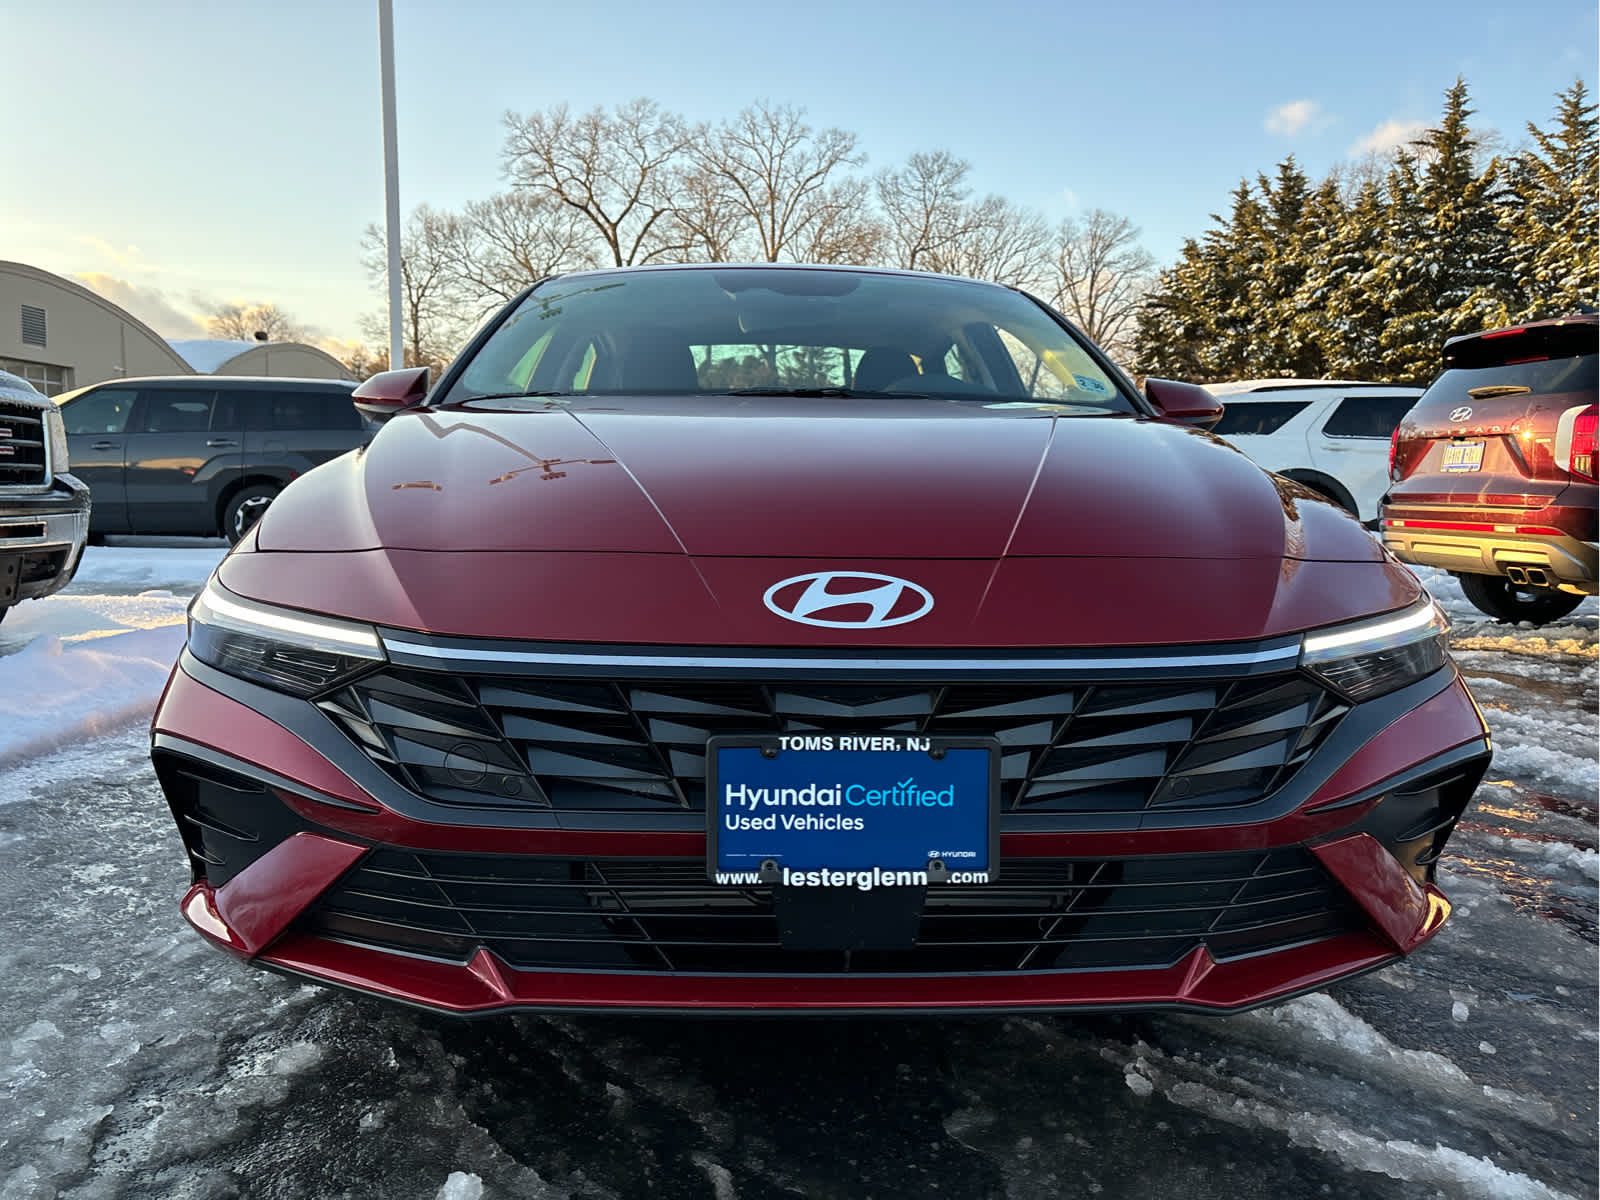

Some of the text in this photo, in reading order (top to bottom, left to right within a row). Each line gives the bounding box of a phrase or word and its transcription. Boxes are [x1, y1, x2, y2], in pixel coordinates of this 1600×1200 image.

[779, 736, 931, 752] TOMS RIVER, NJ
[725, 777, 954, 811] Hyundai Certified
[725, 813, 865, 831] Used Vehicles
[715, 867, 989, 891] www. lesterglenn .com
